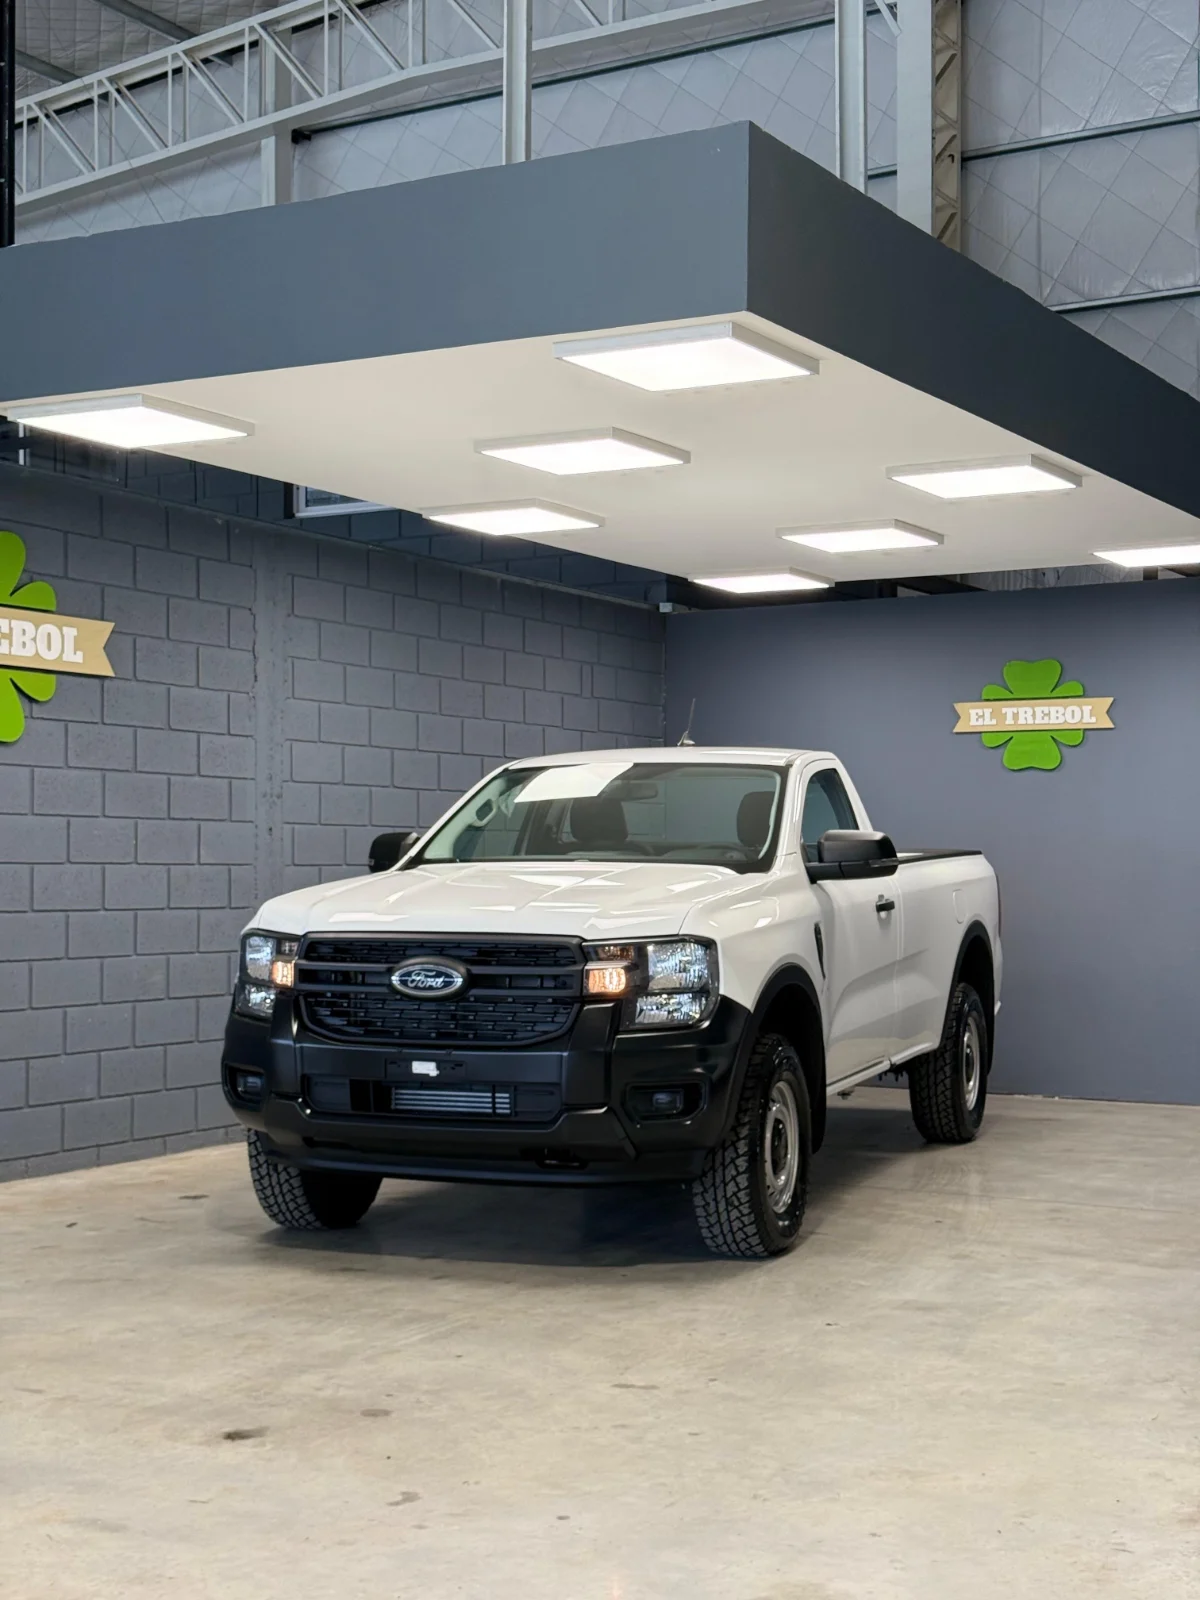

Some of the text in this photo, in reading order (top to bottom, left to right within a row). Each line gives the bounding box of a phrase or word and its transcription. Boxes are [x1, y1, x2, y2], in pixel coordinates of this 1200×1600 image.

[969, 705, 1097, 726] EL TREBOL
[407, 970, 445, 989] Ford
